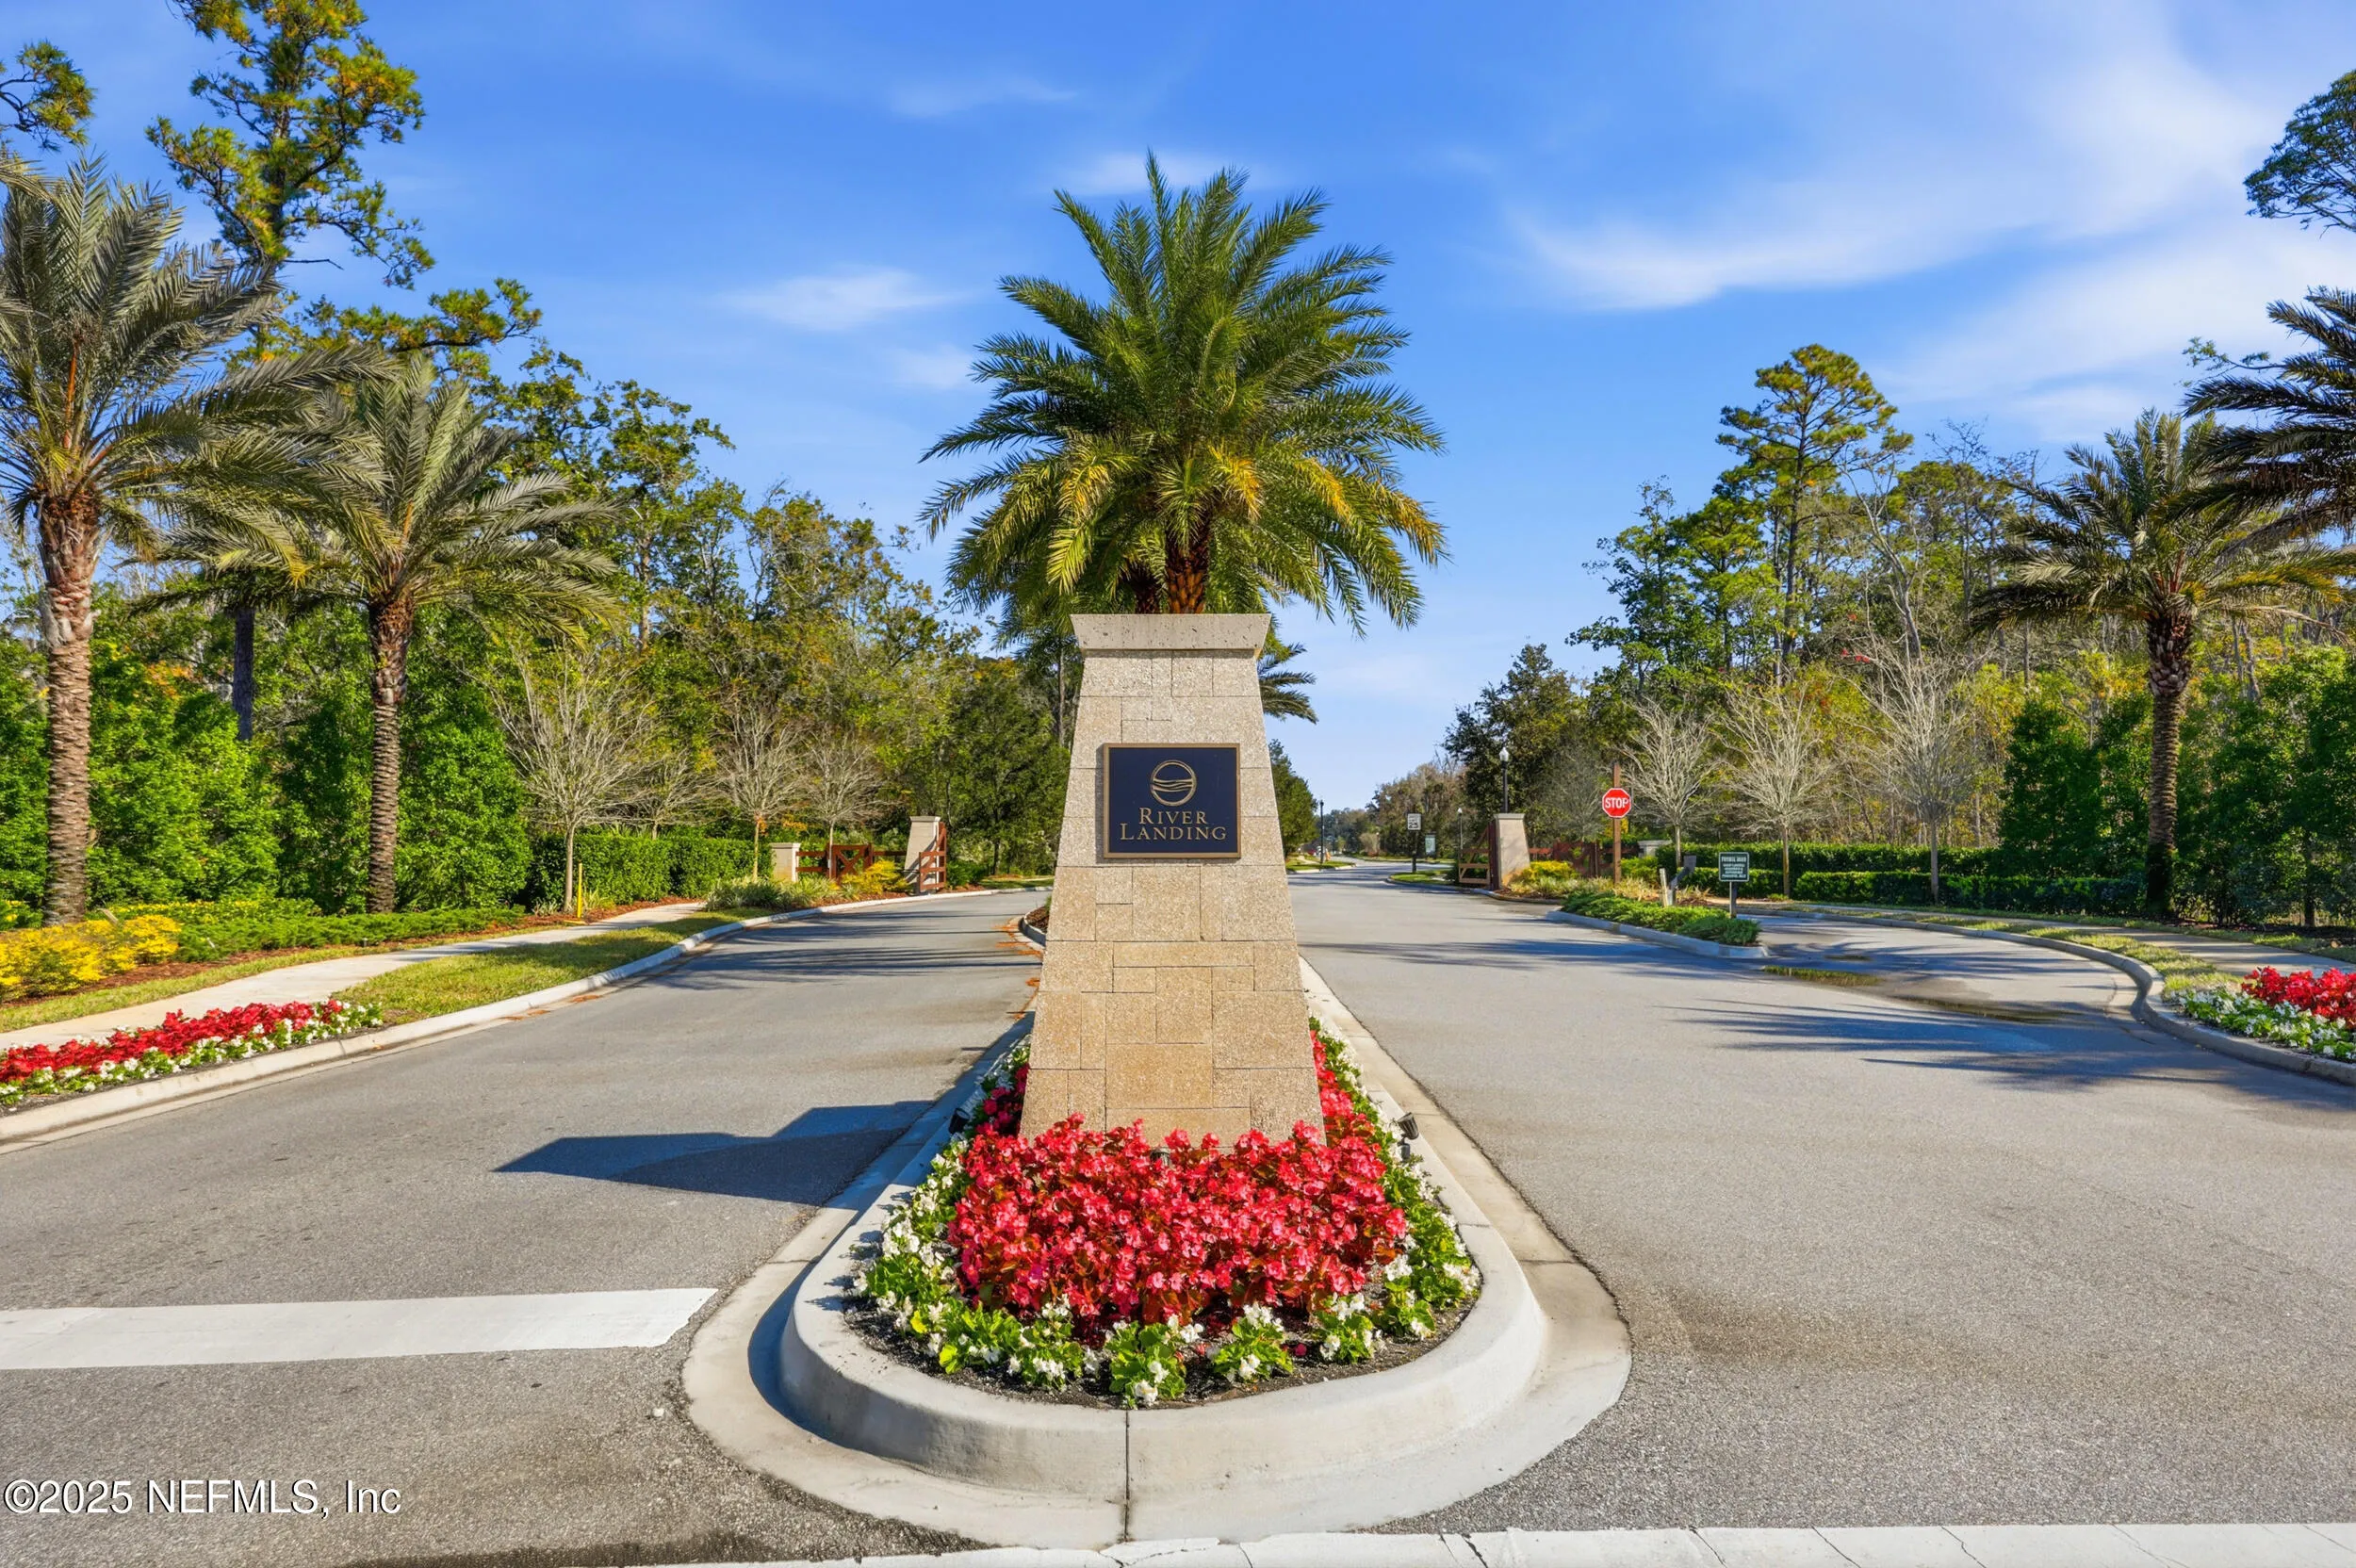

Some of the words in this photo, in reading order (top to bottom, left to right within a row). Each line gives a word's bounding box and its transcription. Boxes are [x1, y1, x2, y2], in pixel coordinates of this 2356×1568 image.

[1605, 797, 1628, 808] STOP
[1138, 808, 1207, 825] RIVER
[1120, 823, 1227, 841] LANDING
